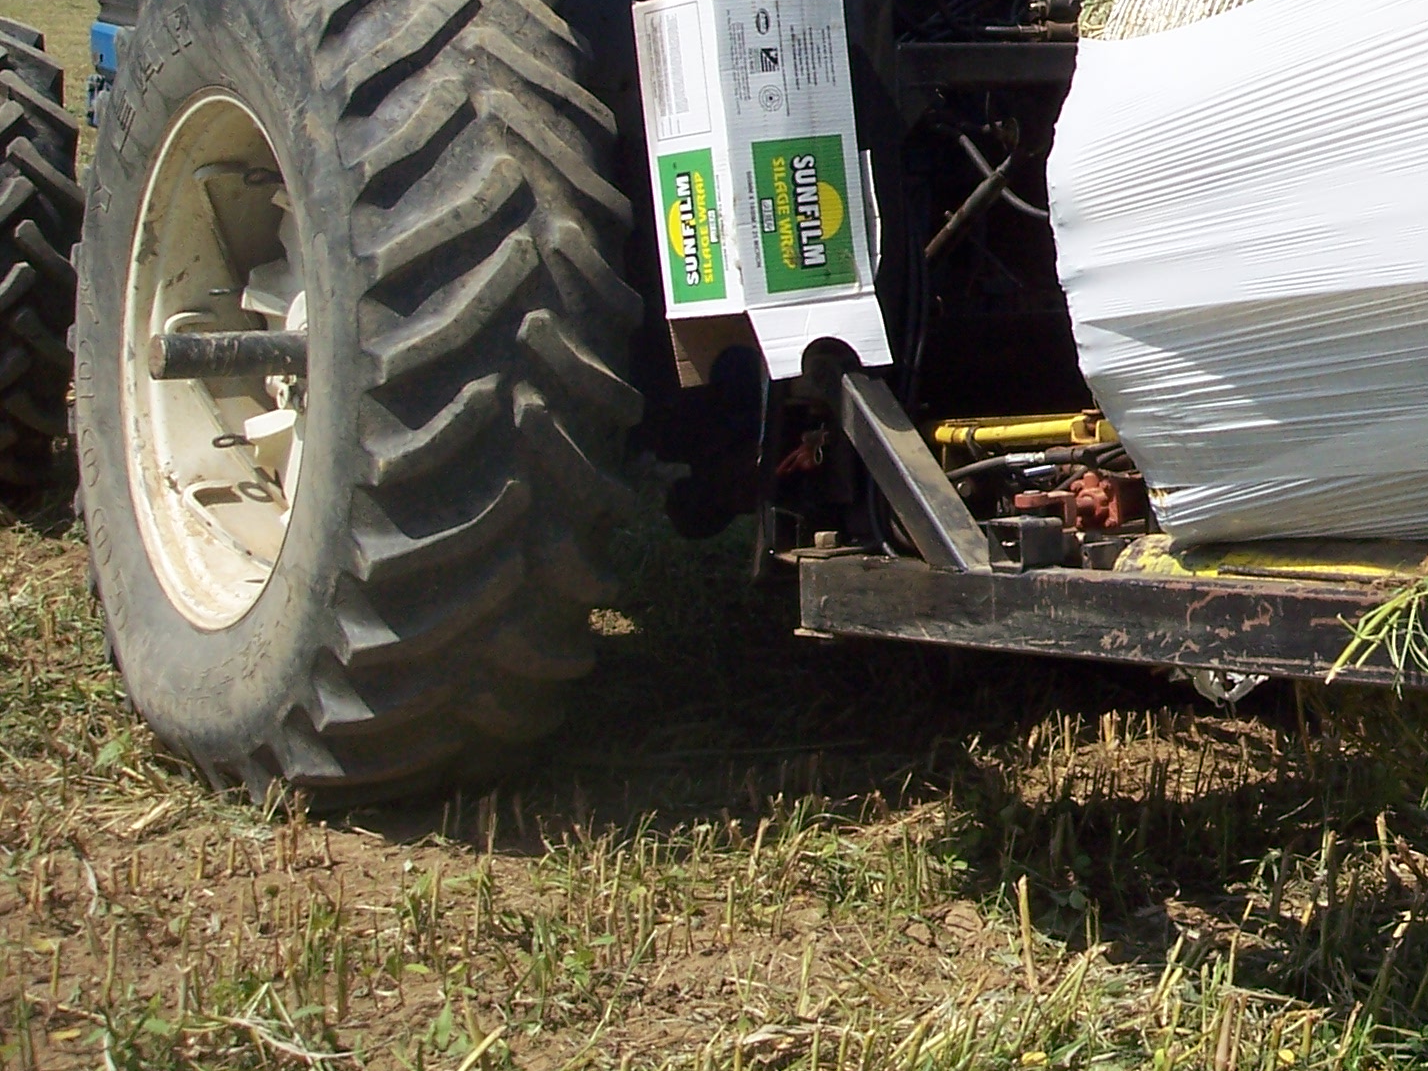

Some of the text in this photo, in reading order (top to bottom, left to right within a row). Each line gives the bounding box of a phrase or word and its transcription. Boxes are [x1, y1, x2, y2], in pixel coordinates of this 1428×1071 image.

[676, 172, 700, 286] SUNFILM
[693, 171, 707, 223] WRAP
[772, 156, 797, 269] SILAGE WRAP
[791, 154, 827, 268] SUNFILM
[700, 226, 714, 284] SILAGE
